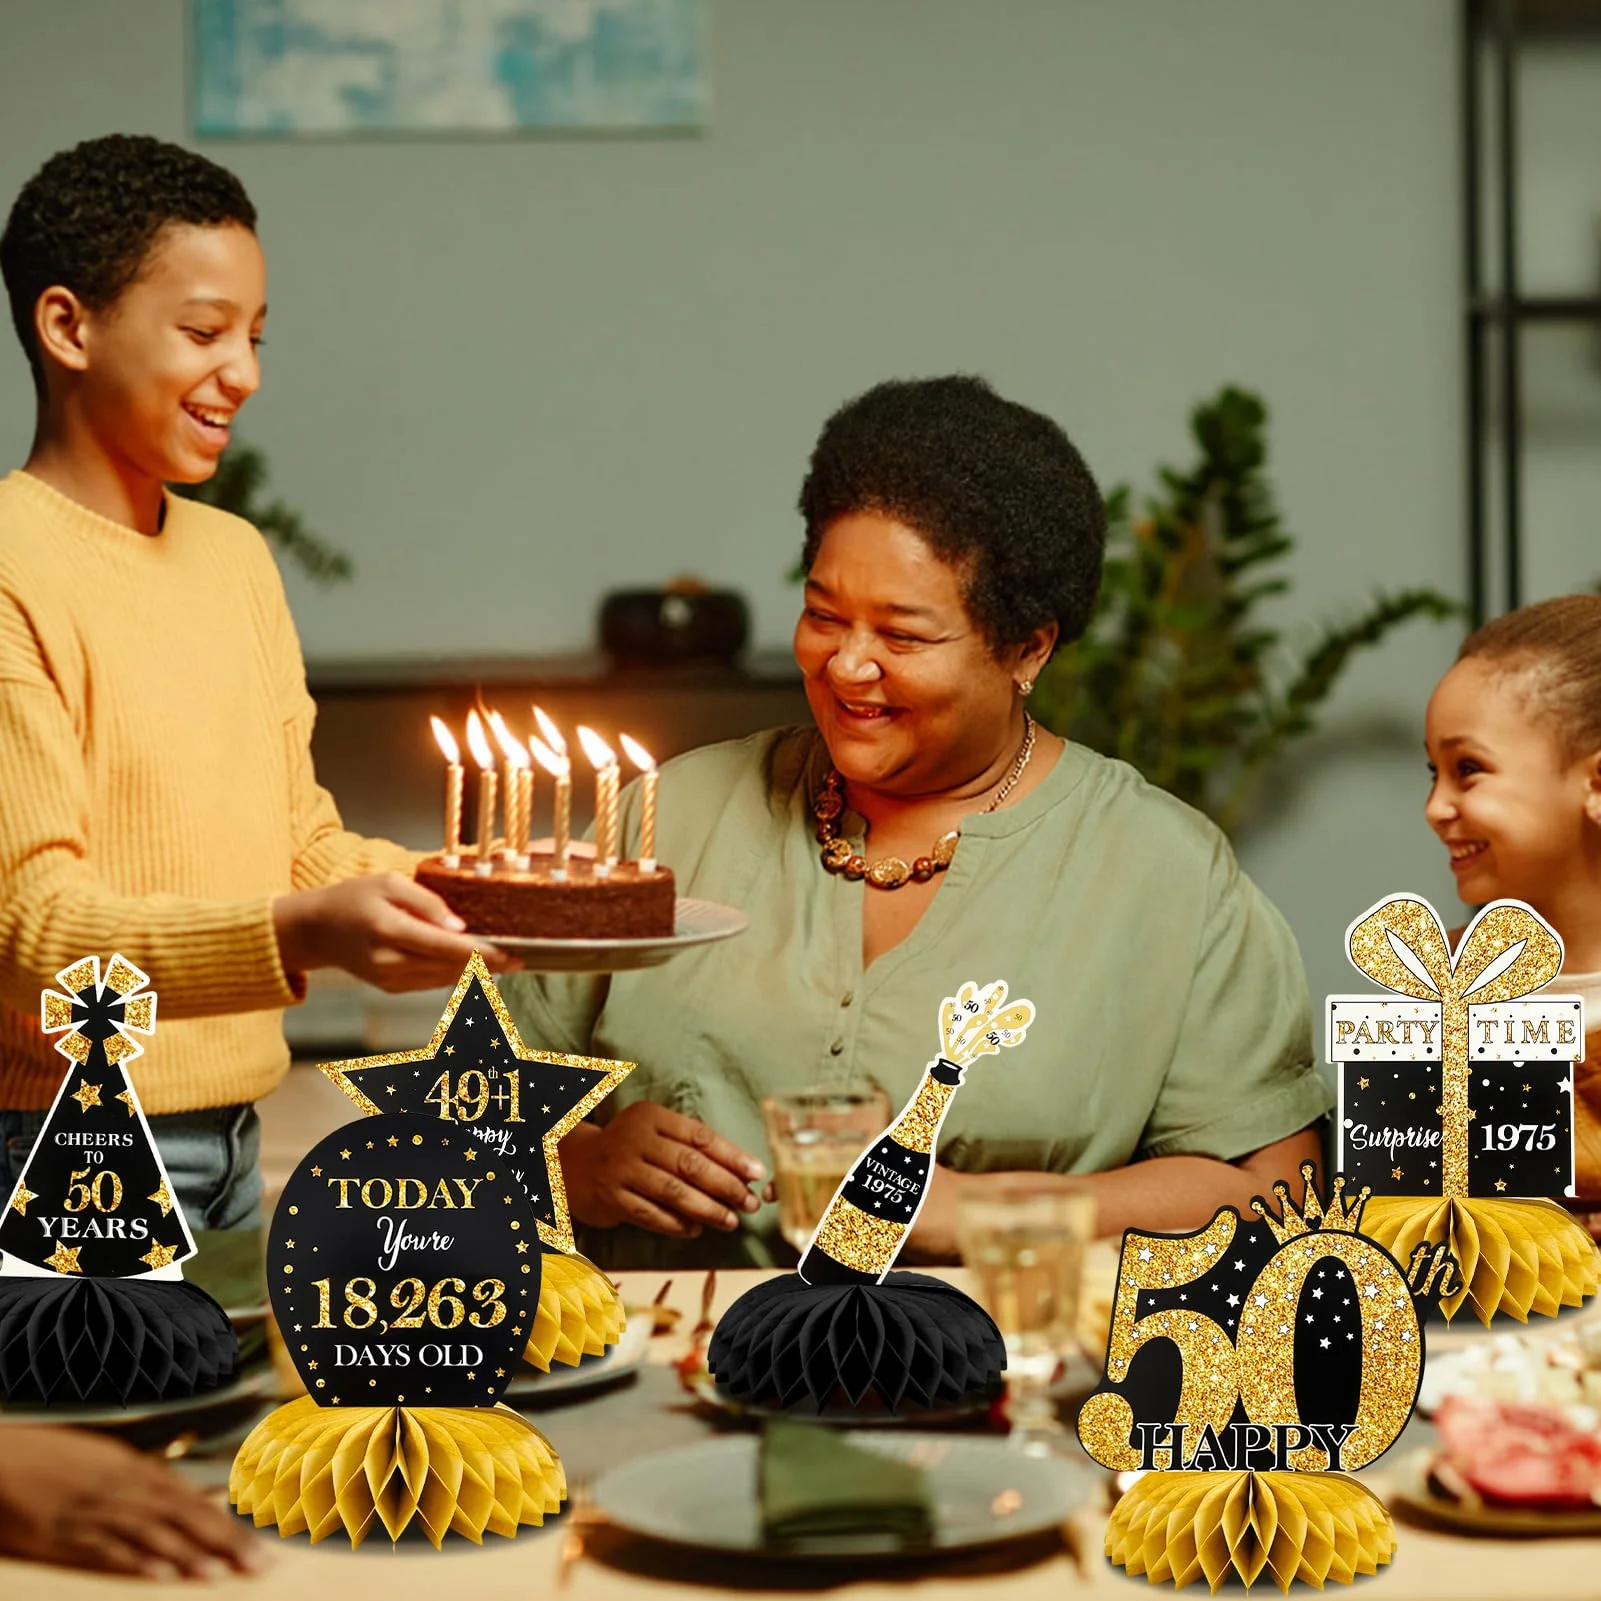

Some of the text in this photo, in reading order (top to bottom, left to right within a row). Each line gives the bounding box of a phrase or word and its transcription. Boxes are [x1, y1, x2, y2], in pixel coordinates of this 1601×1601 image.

[951, 1014, 962, 1022] 50
[964, 1000, 979, 1013] 50
[986, 1031, 1000, 1046] 50
[1336, 1020, 1576, 1044] PARTY TIME
[54, 1132, 134, 1147] CHEERS
[1350, 1123, 1557, 1162] Surprise 1975
[83, 1151, 104, 1165] TO
[865, 1157, 921, 1195] VINTAGE
[63, 1167, 124, 1213] 50
[327, 1178, 484, 1209] TODAY
[861, 1174, 906, 1204] 1975
[37, 1217, 149, 1240] YEARS
[310, 1277, 507, 1335] 18,263
[333, 1344, 484, 1367] DAYS OLD
[1136, 1422, 1359, 1472] HAPPY
